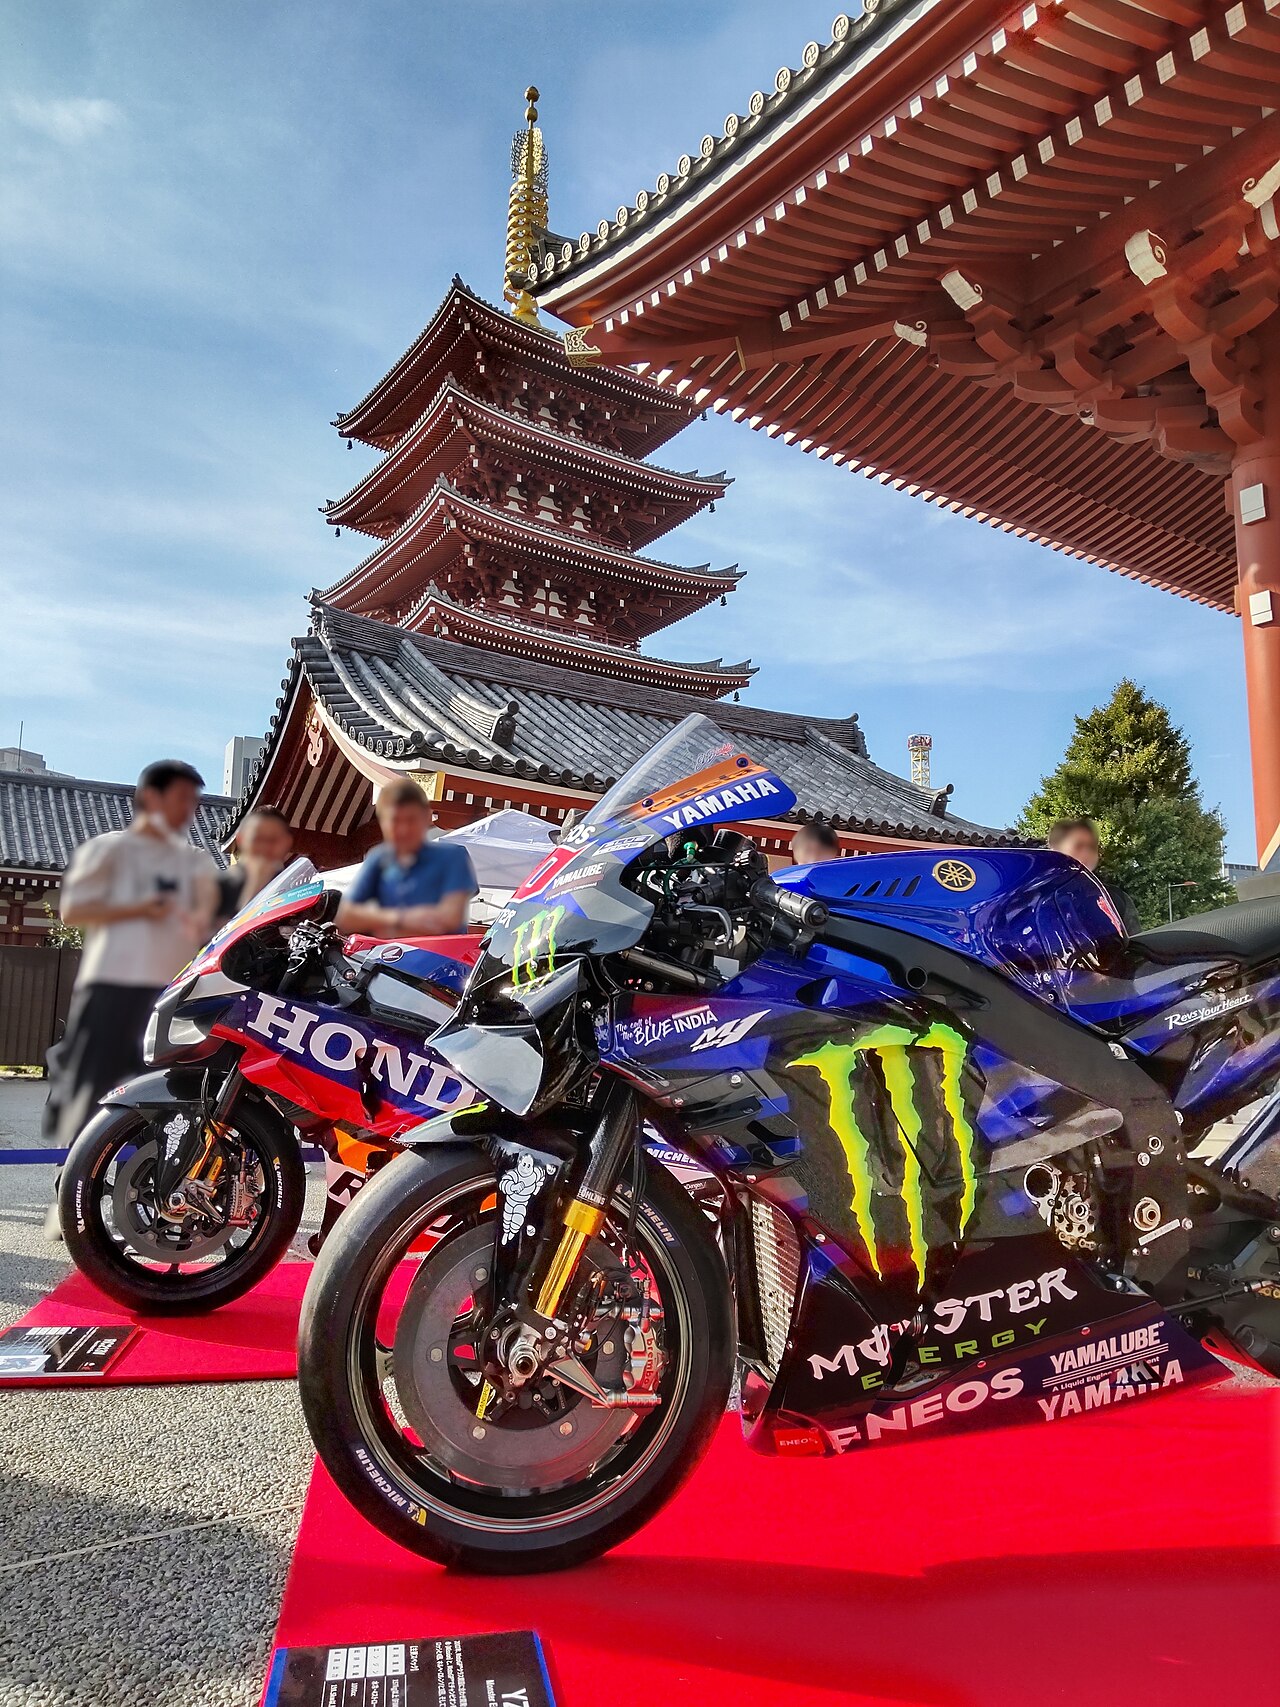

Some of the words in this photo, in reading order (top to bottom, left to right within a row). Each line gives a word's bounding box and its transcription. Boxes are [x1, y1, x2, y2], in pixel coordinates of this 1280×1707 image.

[662, 778, 779, 830] YAMAHA
[553, 862, 606, 889] YAMALUBE
[673, 1010, 718, 1033] INDIA
[1164, 1010, 1198, 1030] Revs
[1197, 1003, 1222, 1021] Your
[1221, 994, 1252, 1011] Heart
[633, 1017, 673, 1047] BLUE
[276, 1171, 284, 1209] MICHELIN
[624, 1190, 675, 1243] MCHELIN
[644, 1337, 655, 1385] brembo
[861, 1318, 1048, 1390] EERGY
[1060, 1377, 1085, 1391] Liquid
[356, 1448, 407, 1507] MICHELIN
[485, 1679, 496, 1702] Monster
